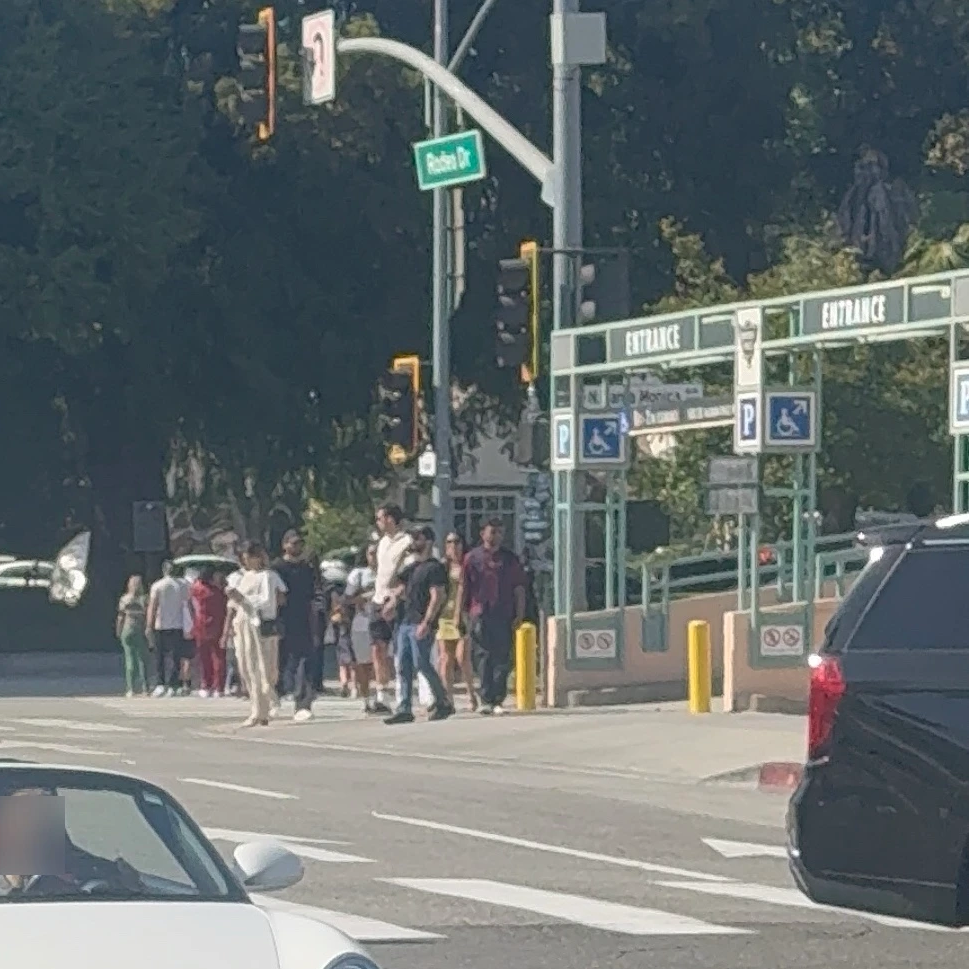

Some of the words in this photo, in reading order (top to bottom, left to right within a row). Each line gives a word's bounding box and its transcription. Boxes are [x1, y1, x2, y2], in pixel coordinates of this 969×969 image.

[456, 146, 471, 169] Dr
[822, 295, 886, 329] ENTRANCE
[625, 324, 680, 357] ENTRANCE
[743, 403, 754, 436] P
[559, 424, 569, 454] P
